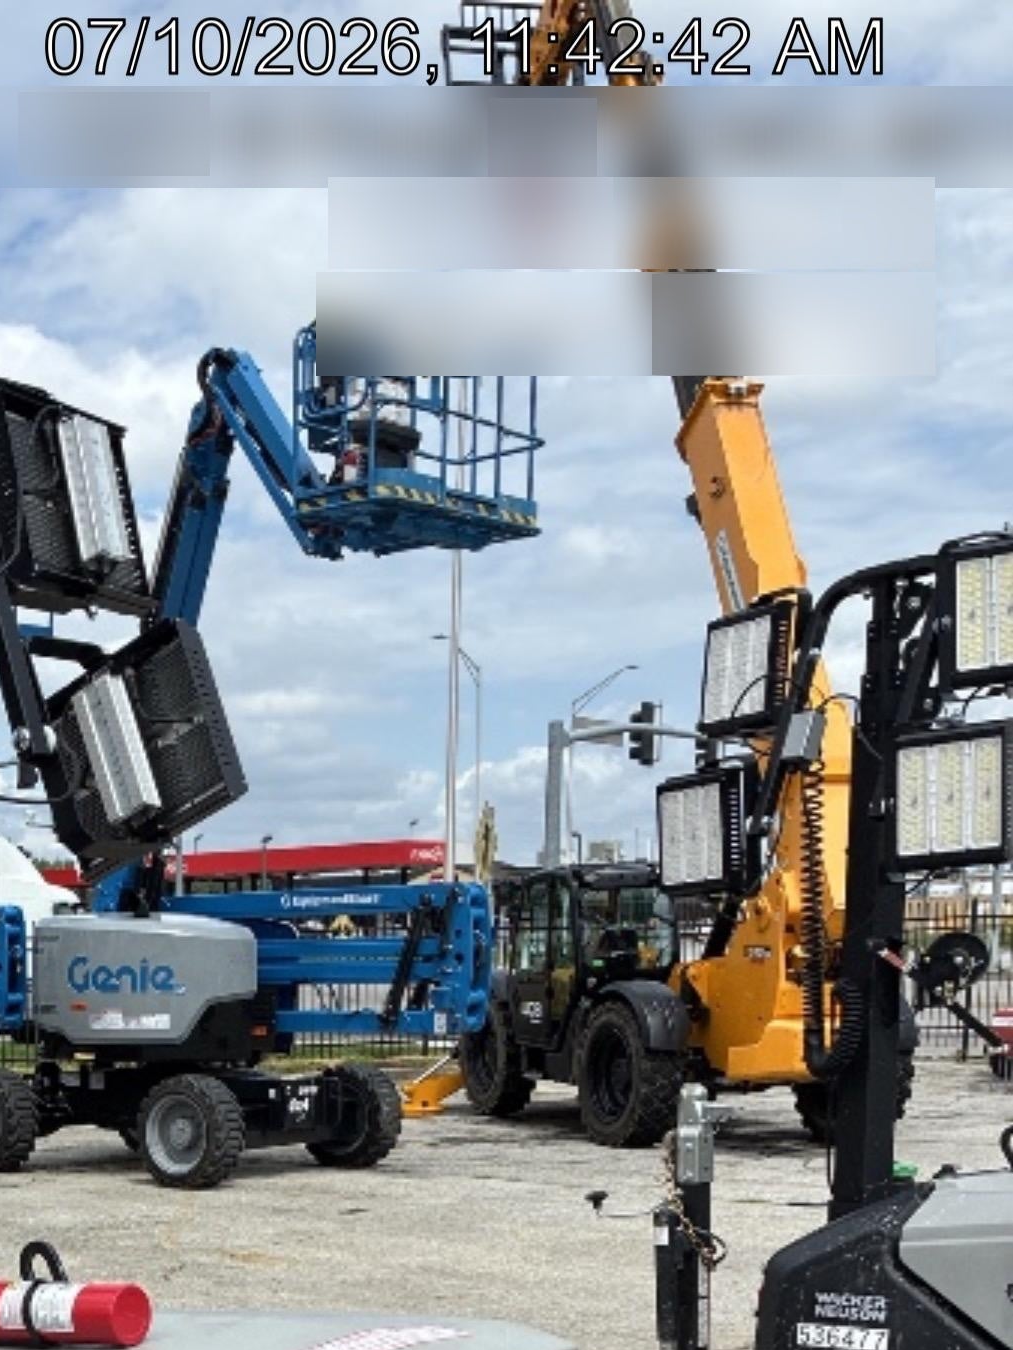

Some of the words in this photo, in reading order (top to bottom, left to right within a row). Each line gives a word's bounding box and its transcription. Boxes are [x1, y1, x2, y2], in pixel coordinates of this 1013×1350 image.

[67, 955, 175, 994] Genie
[814, 1291, 887, 1309] WACKER
[814, 1304, 887, 1323] NEUSON
